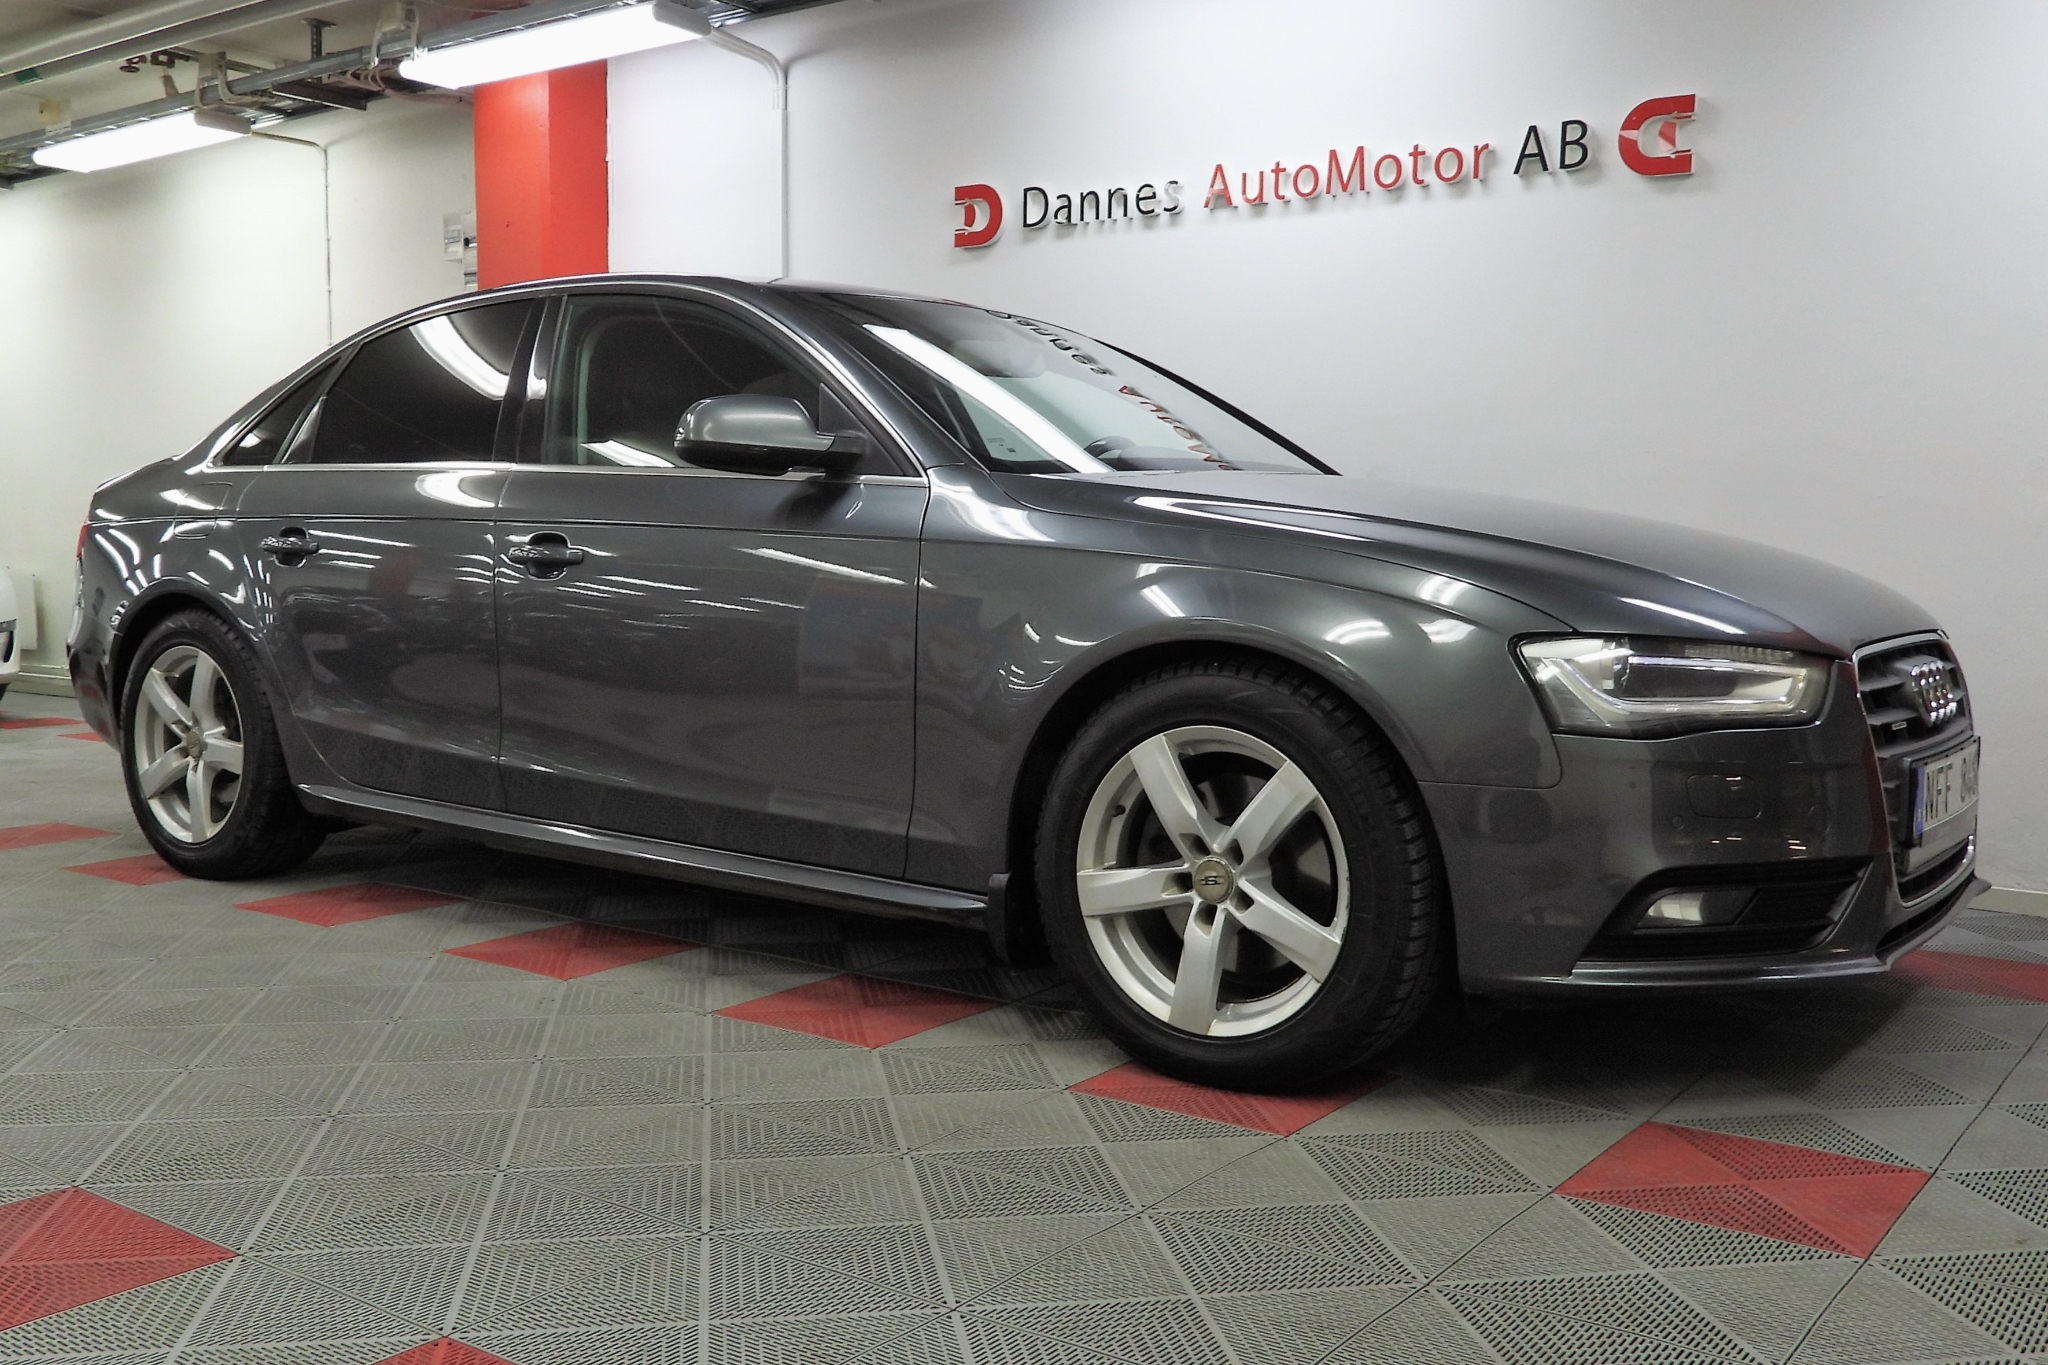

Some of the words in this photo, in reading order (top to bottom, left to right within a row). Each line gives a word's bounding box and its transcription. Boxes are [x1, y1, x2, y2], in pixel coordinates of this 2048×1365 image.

[1023, 179, 1184, 229] Dannes
[1203, 143, 1490, 208] AutoMotor
[1513, 119, 1589, 175] AB
[1925, 761, 1953, 823] NFF
